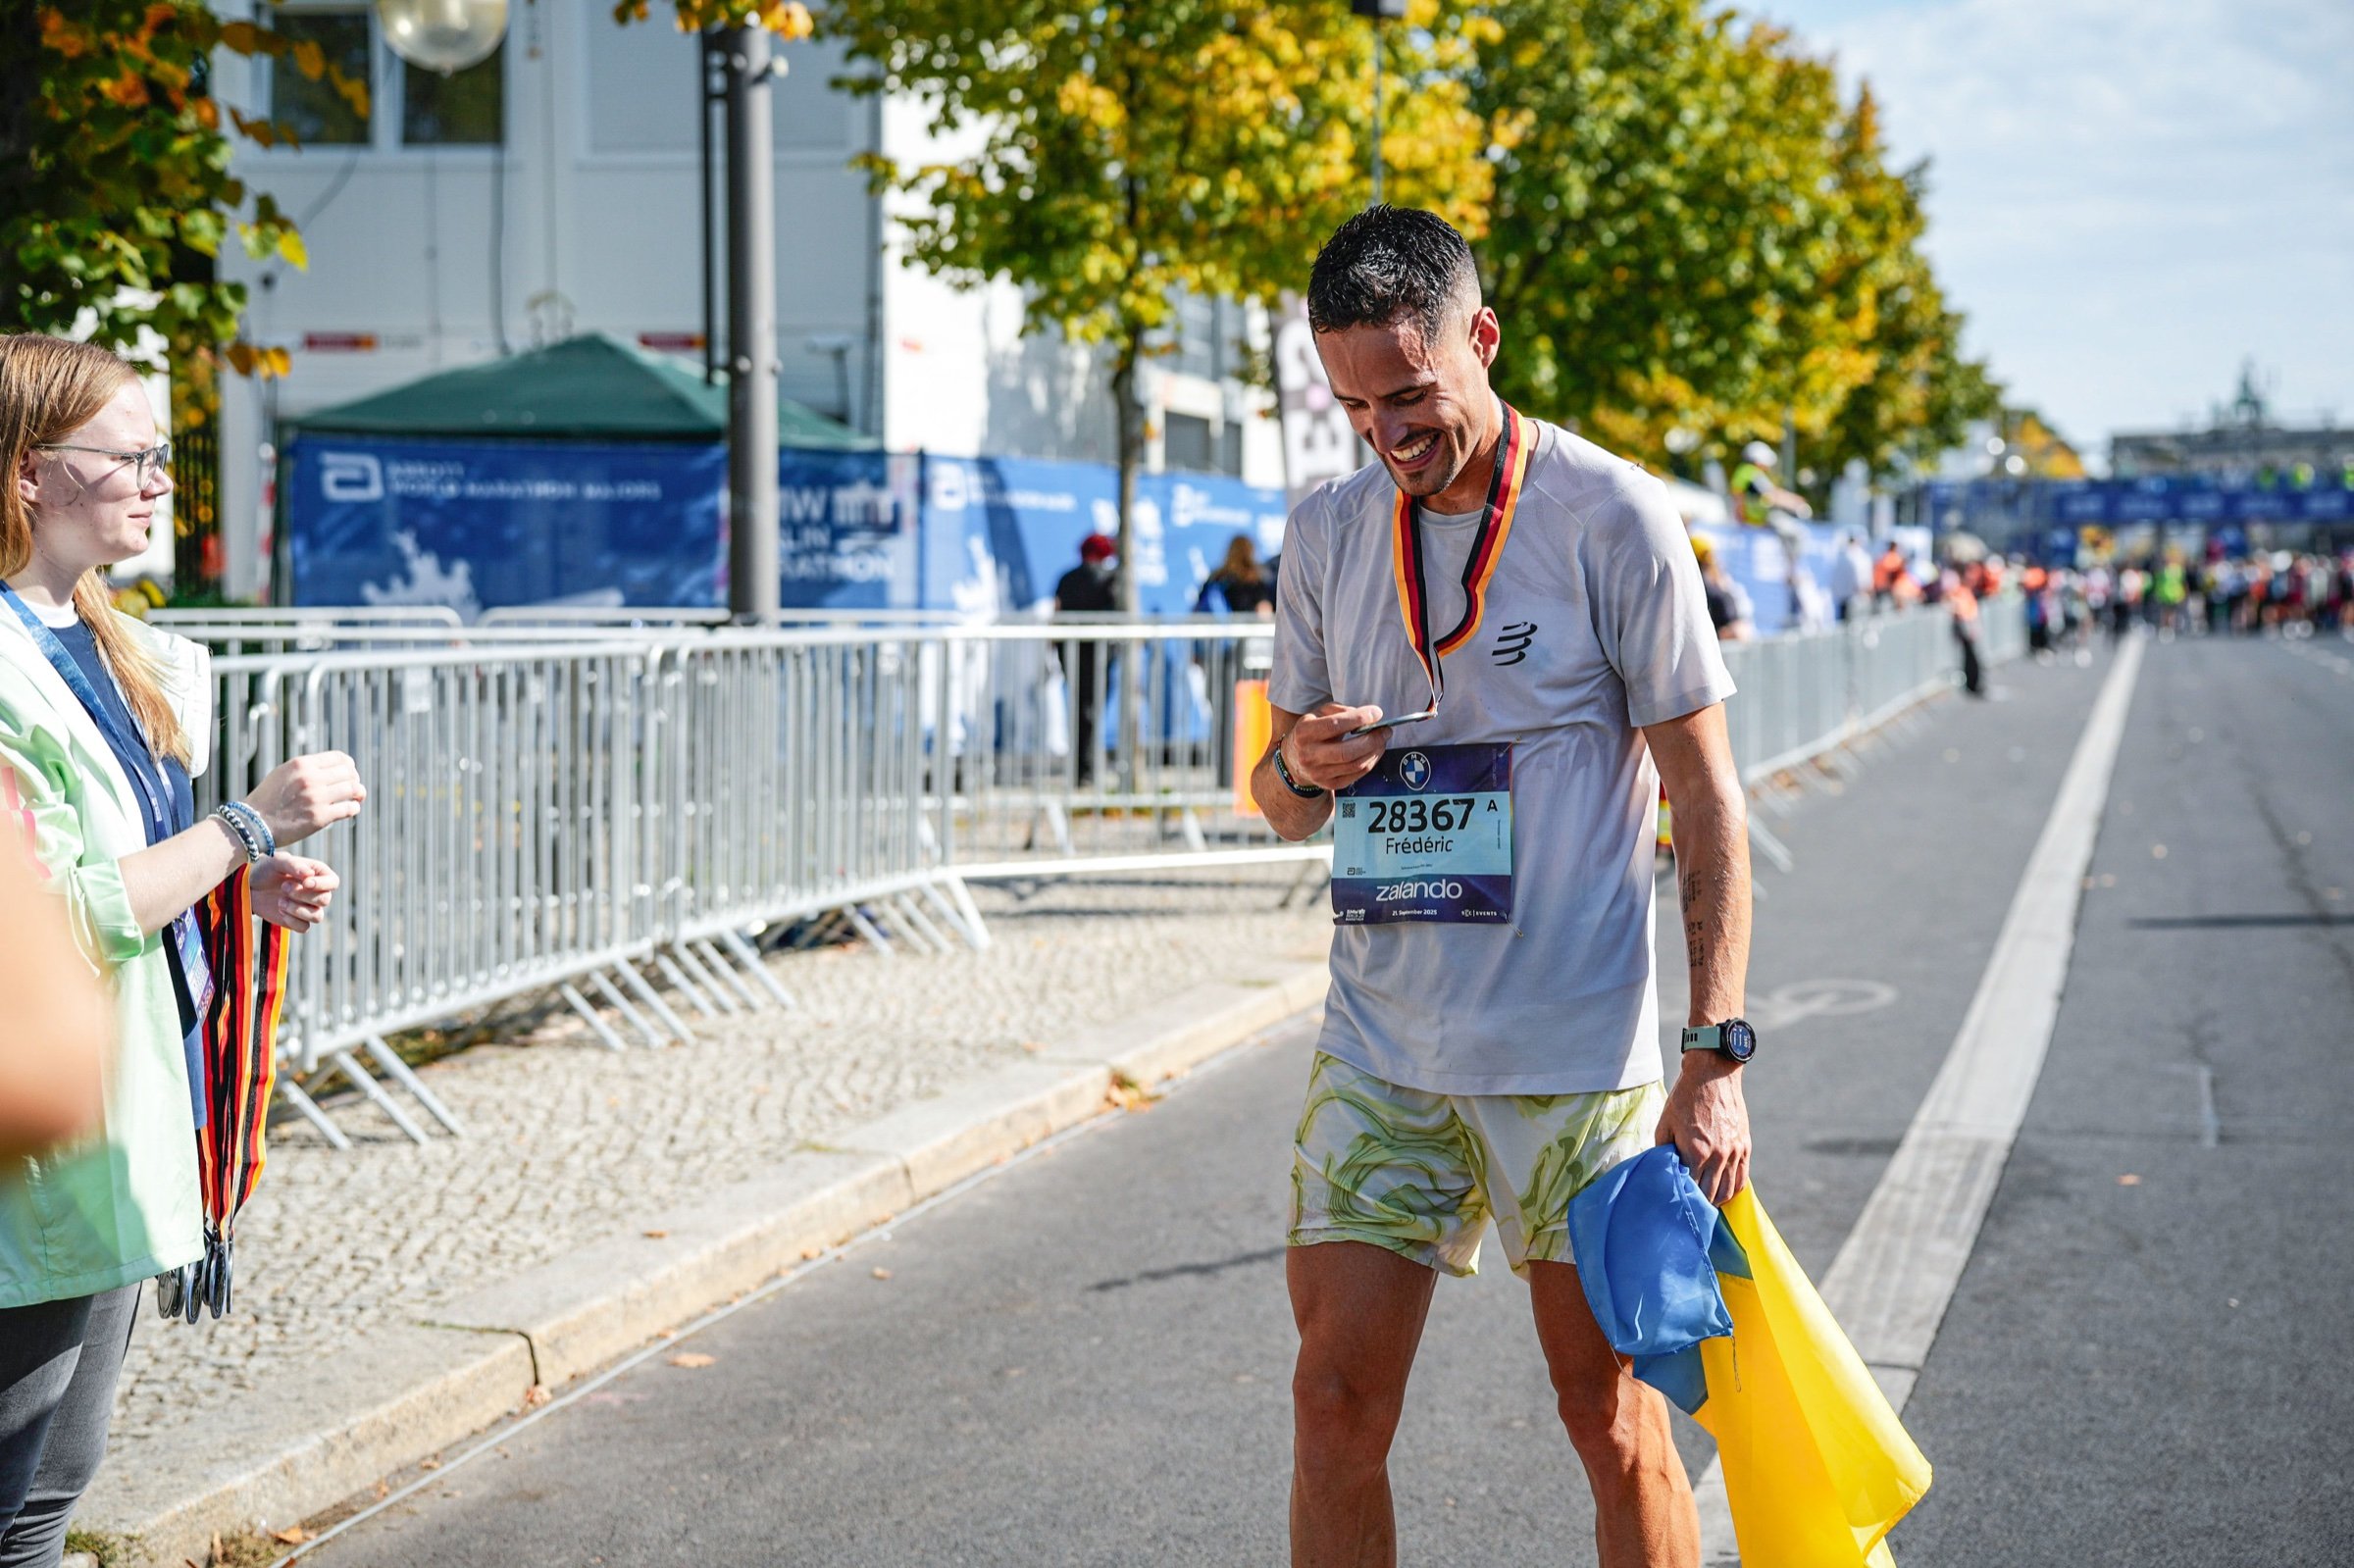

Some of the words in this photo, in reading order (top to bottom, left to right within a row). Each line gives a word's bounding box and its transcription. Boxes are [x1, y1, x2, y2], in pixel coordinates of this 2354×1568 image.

[1367, 798, 1475, 834] 28367
[1486, 799, 1498, 812] A
[1386, 835, 1454, 855] Frédéric
[1375, 879, 1462, 902] zalando
